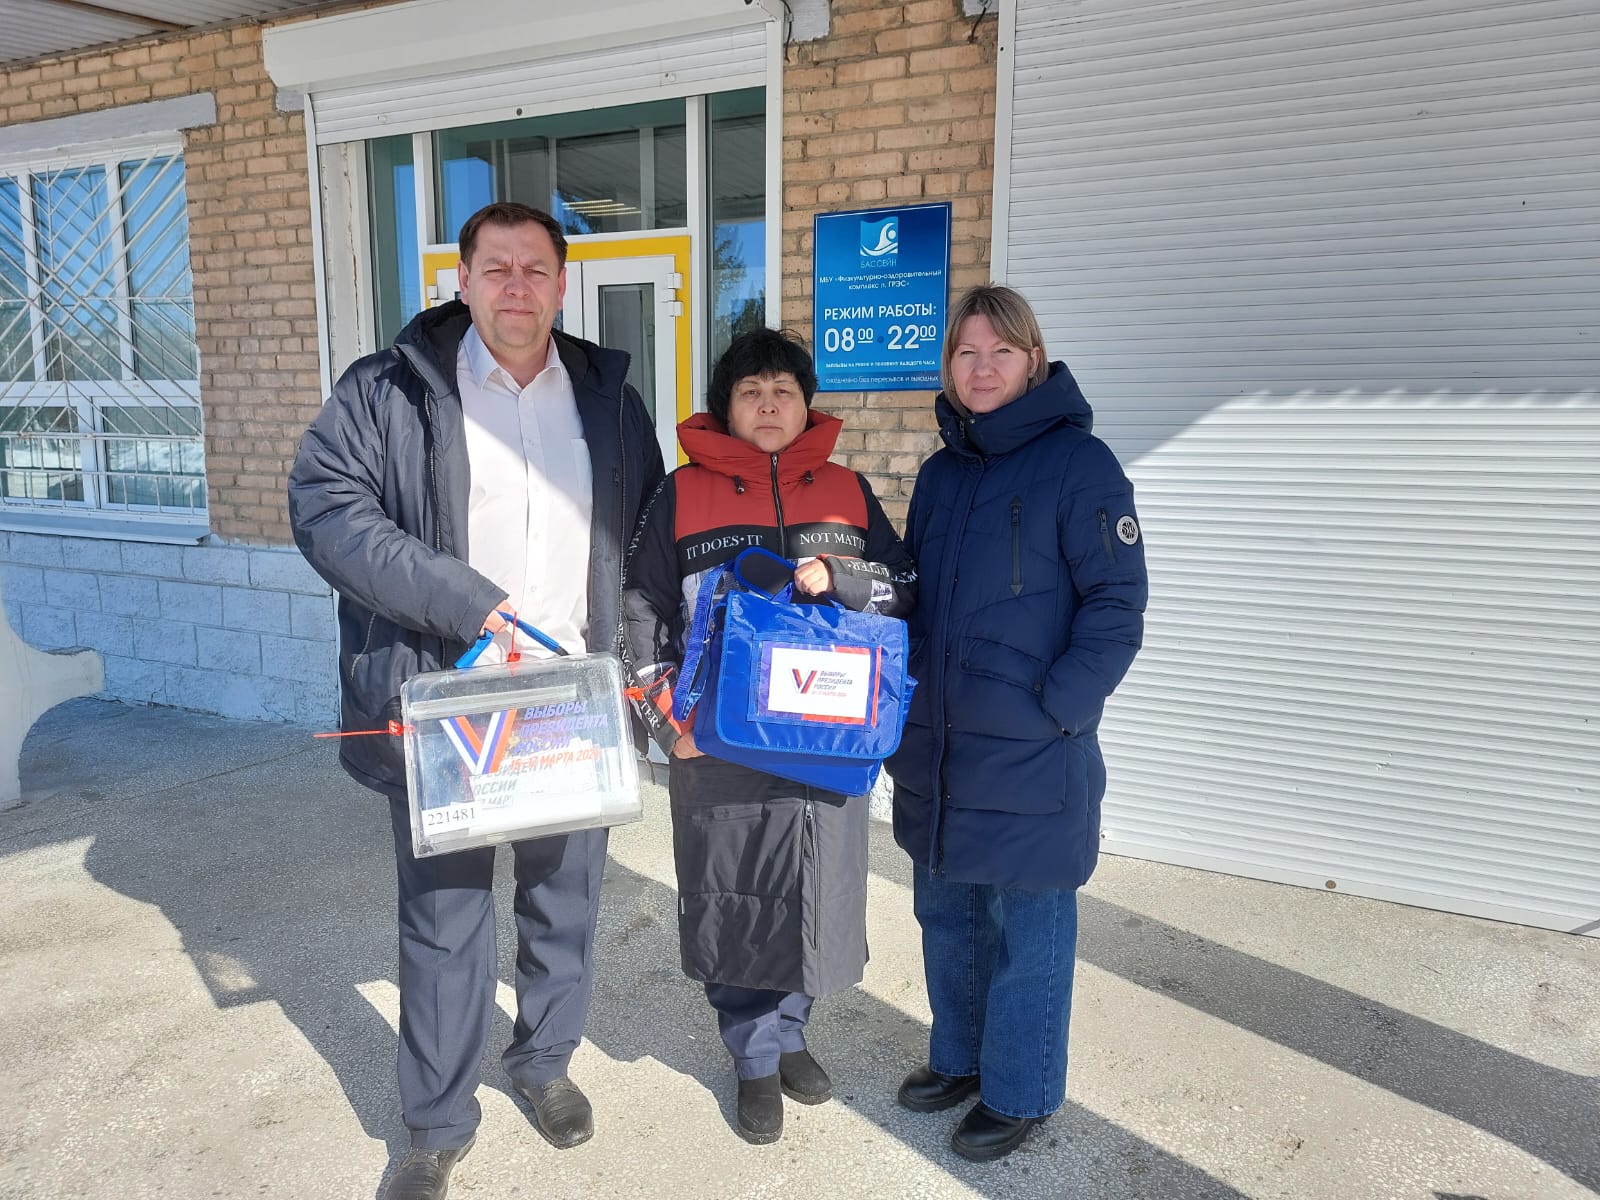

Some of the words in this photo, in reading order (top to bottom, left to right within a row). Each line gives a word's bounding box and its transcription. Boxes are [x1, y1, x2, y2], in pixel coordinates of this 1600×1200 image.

[861, 258, 897, 269] БАССЕЙН
[819, 276, 833, 284] МБУ
[824, 305, 874, 321] РЕЖИМ
[879, 303, 937, 318] РАБОТЫ:
[685, 544, 699, 561] IT
[747, 534, 763, 546] IT
[799, 532, 832, 545] NOT
[524, 700, 588, 720] ВЫБОРЫ
[520, 713, 608, 738] ПРЕЗИДЕНТА
[539, 751, 574, 767] МАРТА
[427, 806, 476, 826] 221481
